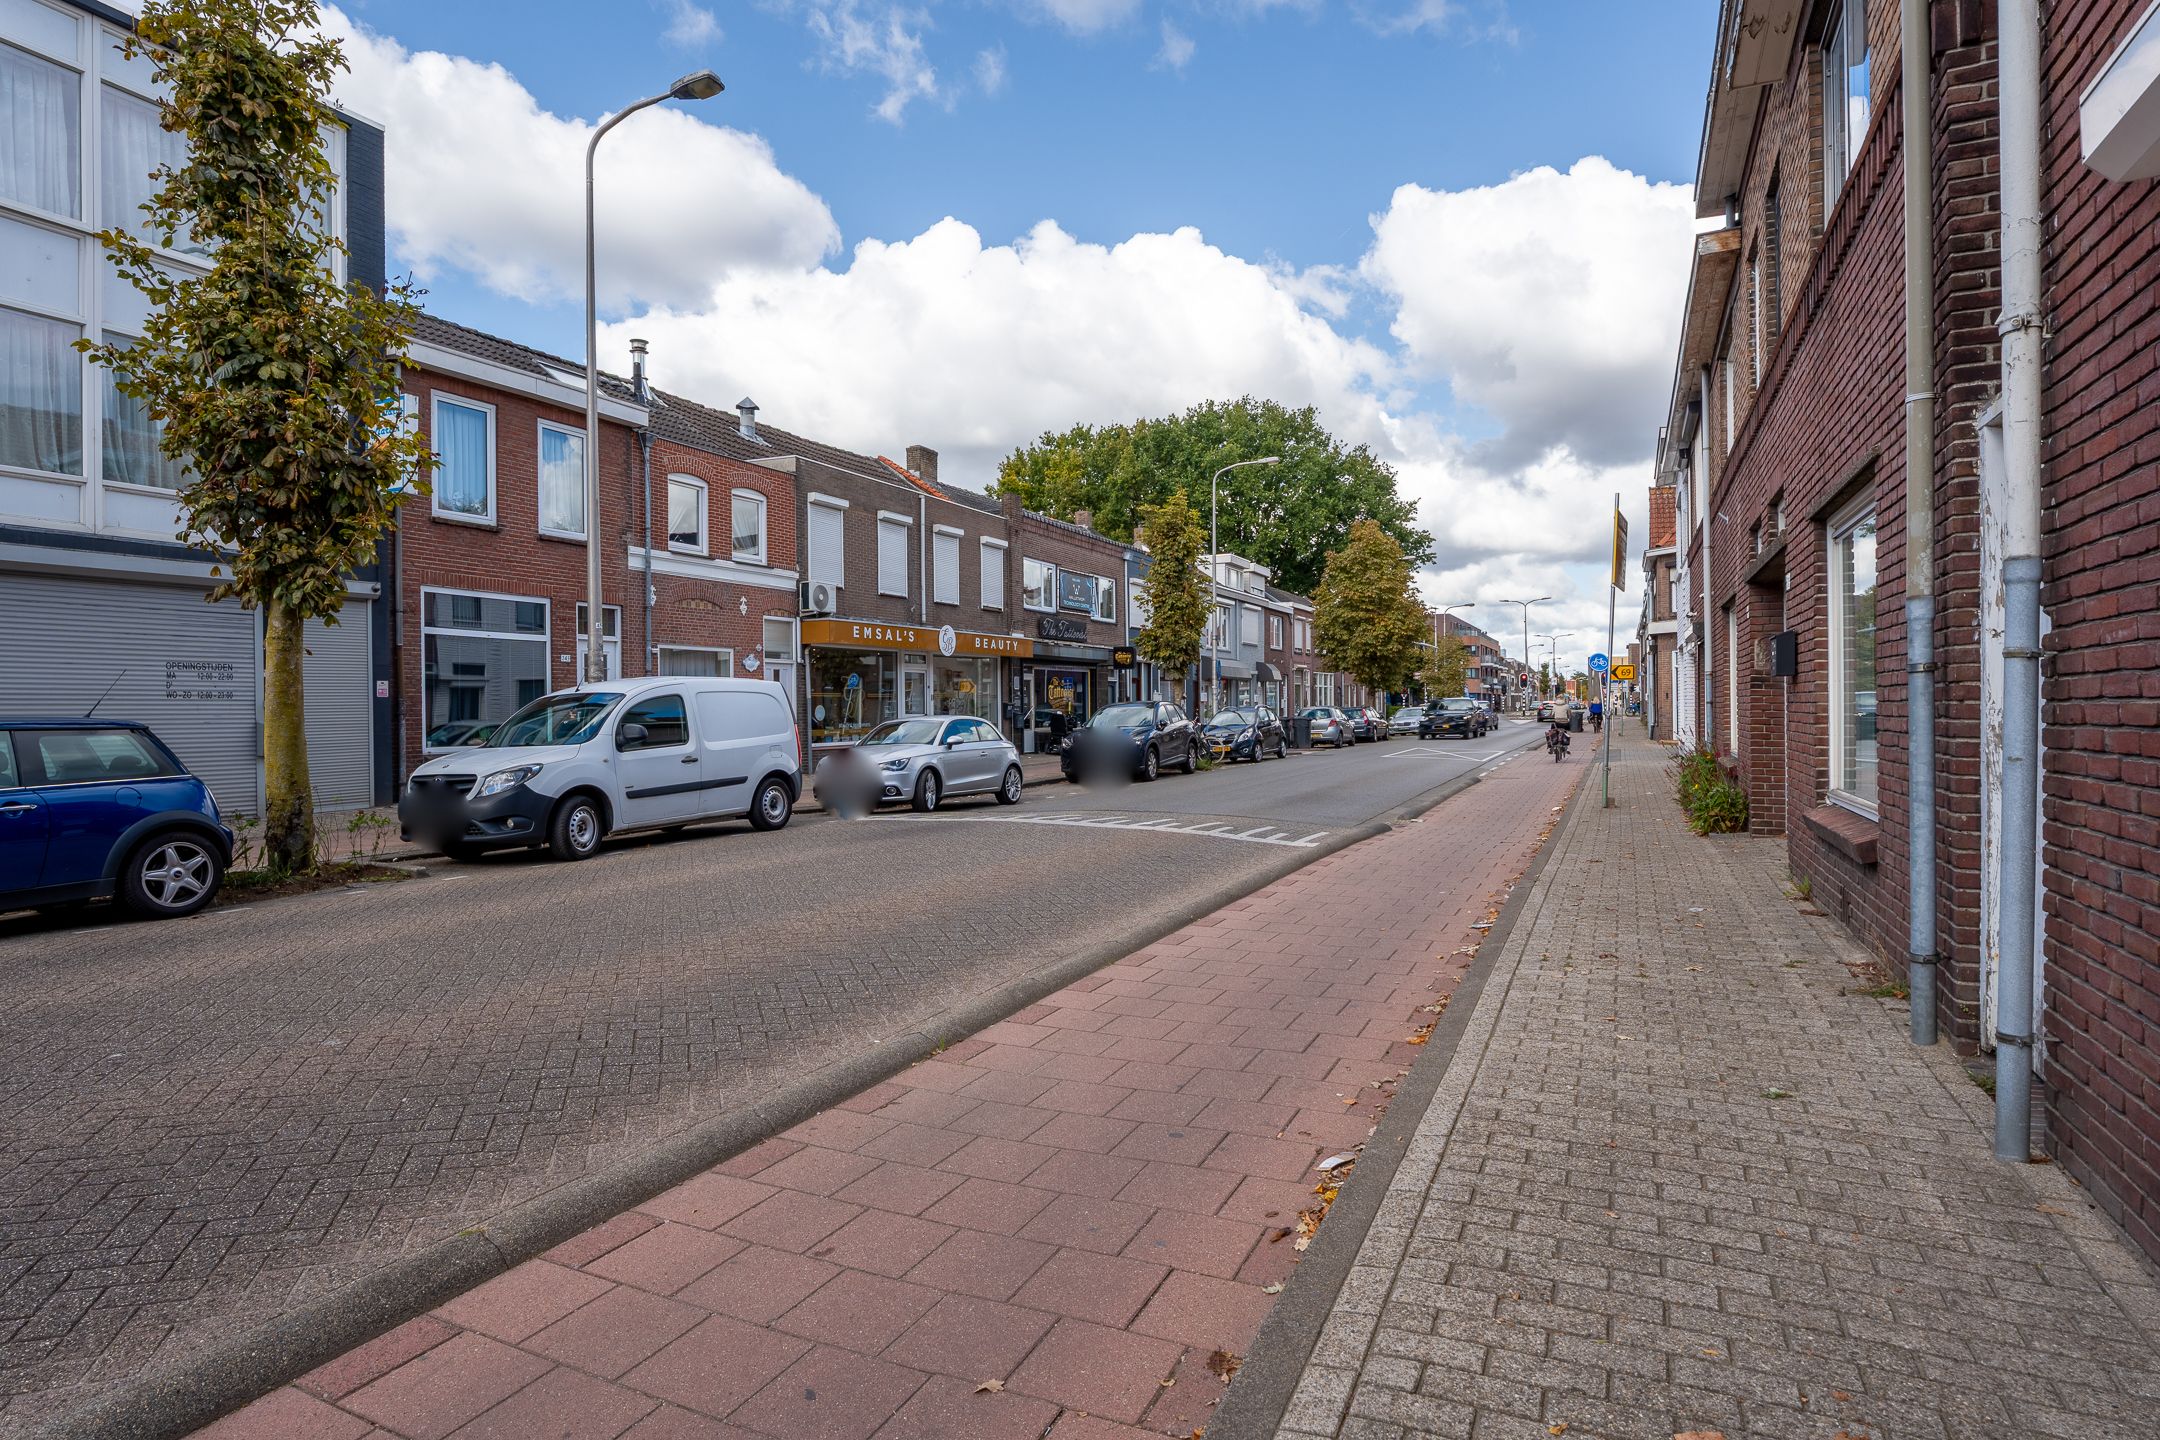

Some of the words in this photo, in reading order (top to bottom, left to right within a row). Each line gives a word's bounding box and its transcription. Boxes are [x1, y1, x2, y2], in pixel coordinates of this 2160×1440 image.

[853, 625, 915, 643] EMSAL'S
[975, 637, 1019, 651] BEAUTY
[165, 661, 233, 671] OPENINGSTIJDEN
[166, 671, 177, 679] MA
[1621, 668, 1631, 676] 69
